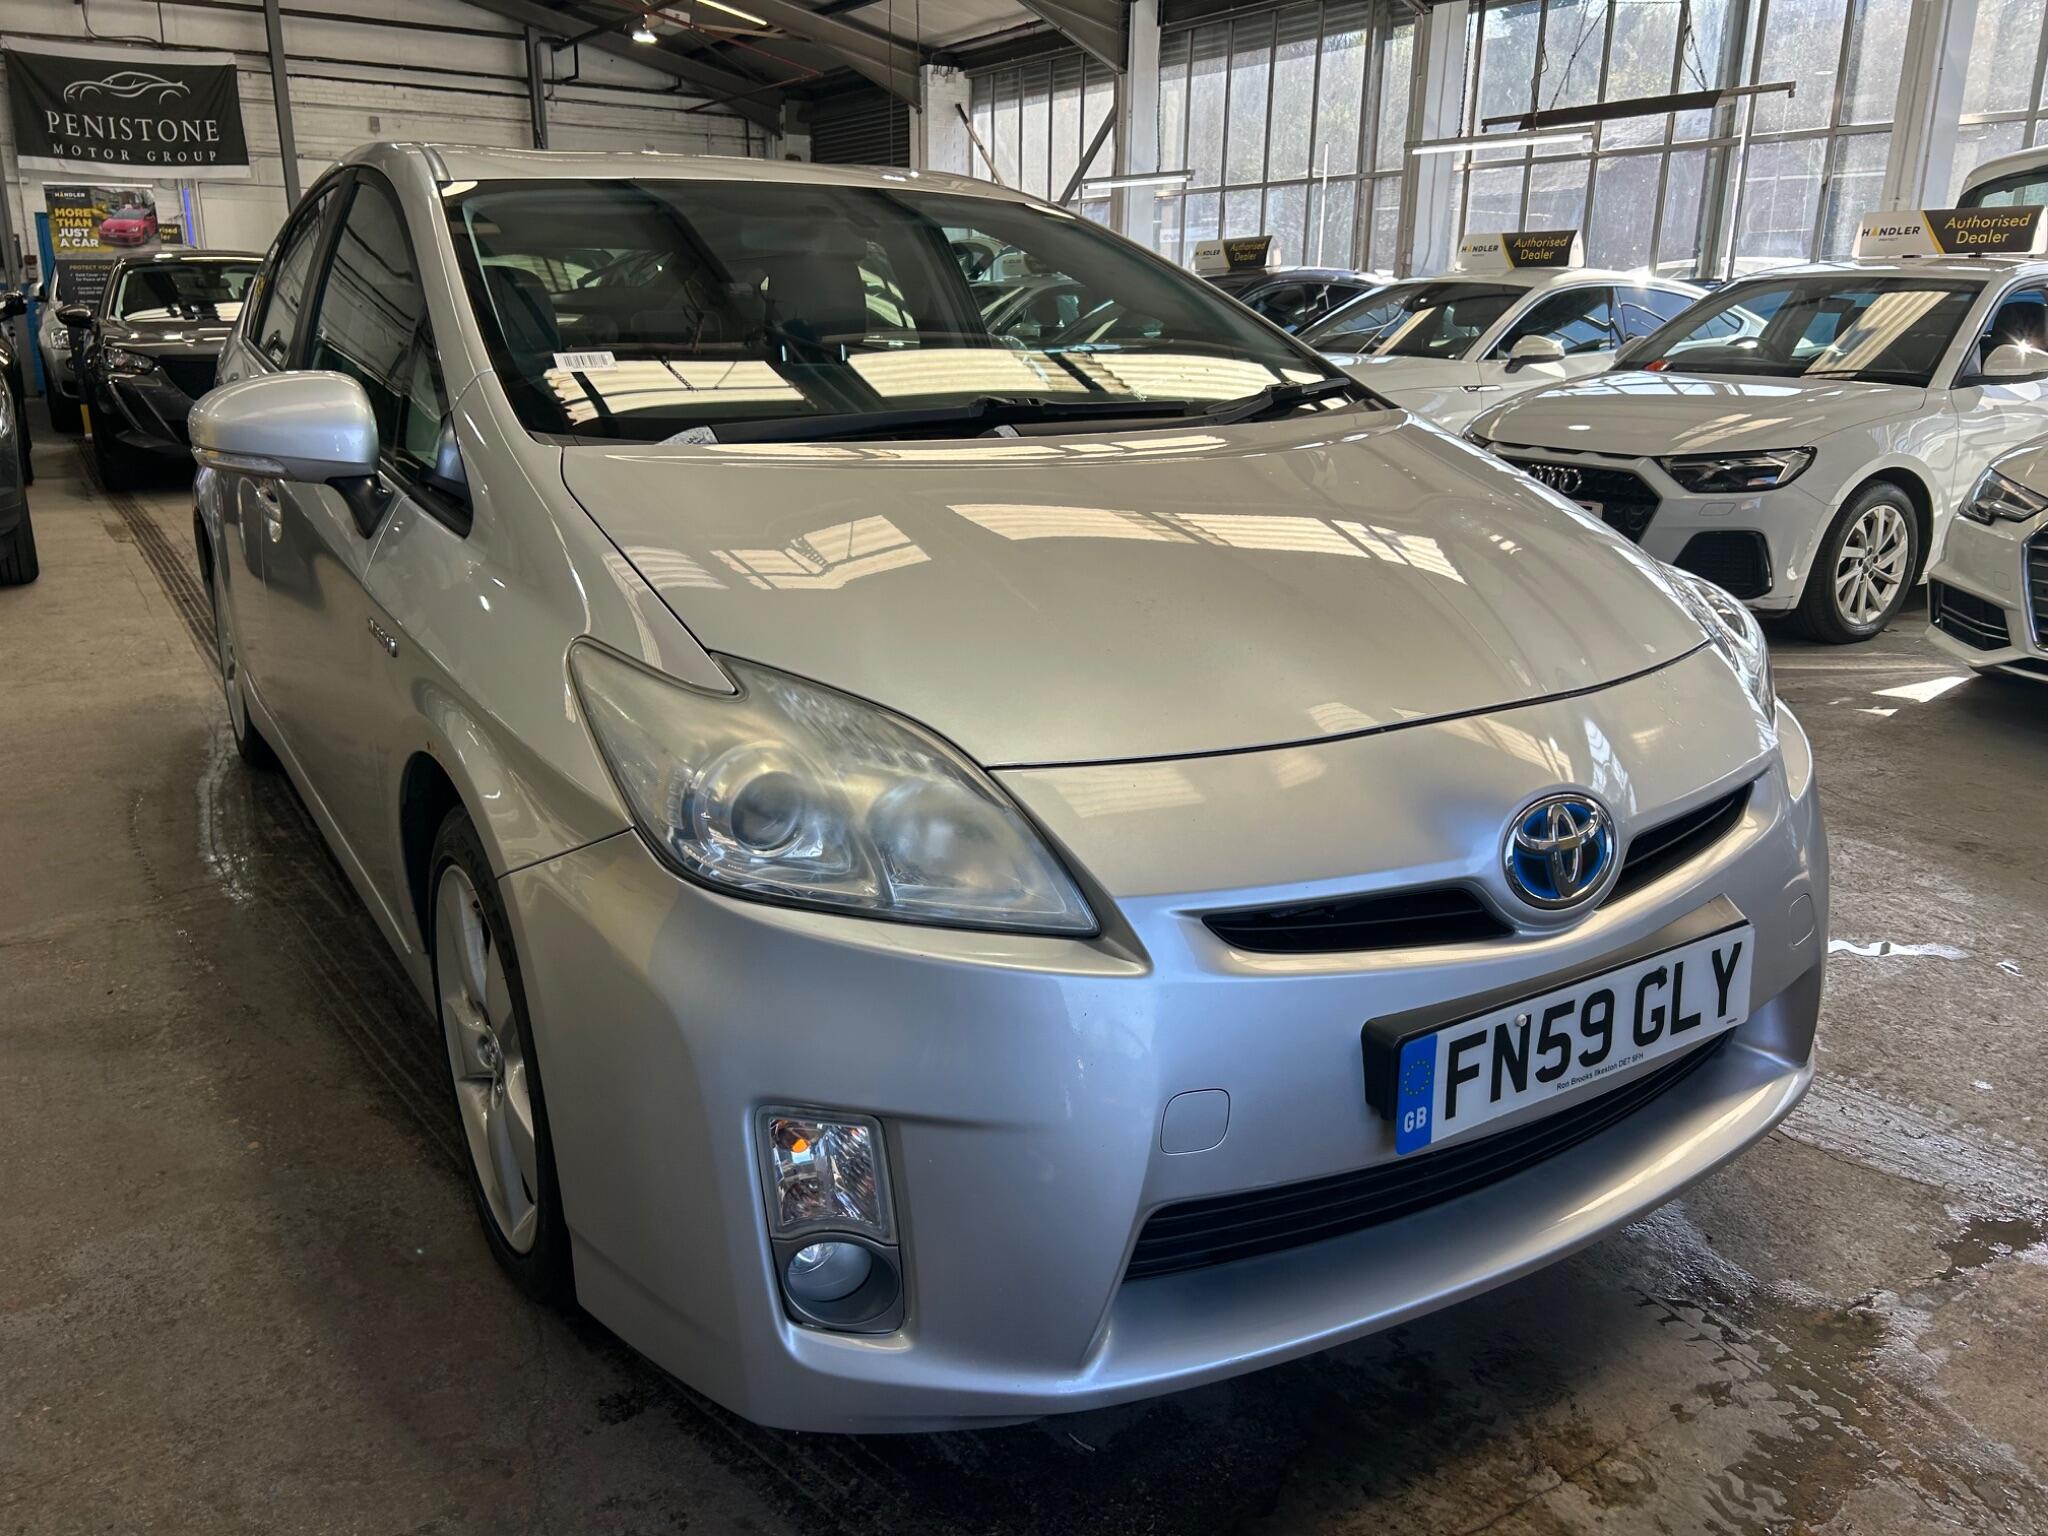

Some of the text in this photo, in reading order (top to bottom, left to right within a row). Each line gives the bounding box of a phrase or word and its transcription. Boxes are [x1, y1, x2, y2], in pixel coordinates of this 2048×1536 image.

[45, 110, 220, 143] PENISTONE
[52, 143, 218, 162] MOTOR GROUP
[54, 208, 92, 217] MORE
[55, 218, 93, 228] THAN
[1944, 213, 2032, 230] Authorised
[58, 228, 90, 238] JUST
[159, 226, 178, 235] rised
[60, 238, 99, 248] A CAR
[1513, 236, 1569, 248] Authorised
[1955, 231, 2010, 244] Dealer
[1231, 241, 1267, 251] Authorised
[1233, 252, 1257, 262] Dealer
[1520, 249, 1554, 260] Dealer
[1444, 941, 1743, 1121] FN59 GLY
[1556, 1080, 1570, 1091] Ron
[1571, 1072, 1593, 1085] Brooks
[1594, 1062, 1618, 1077] Ilkeston
[1403, 1105, 1427, 1134] GB
